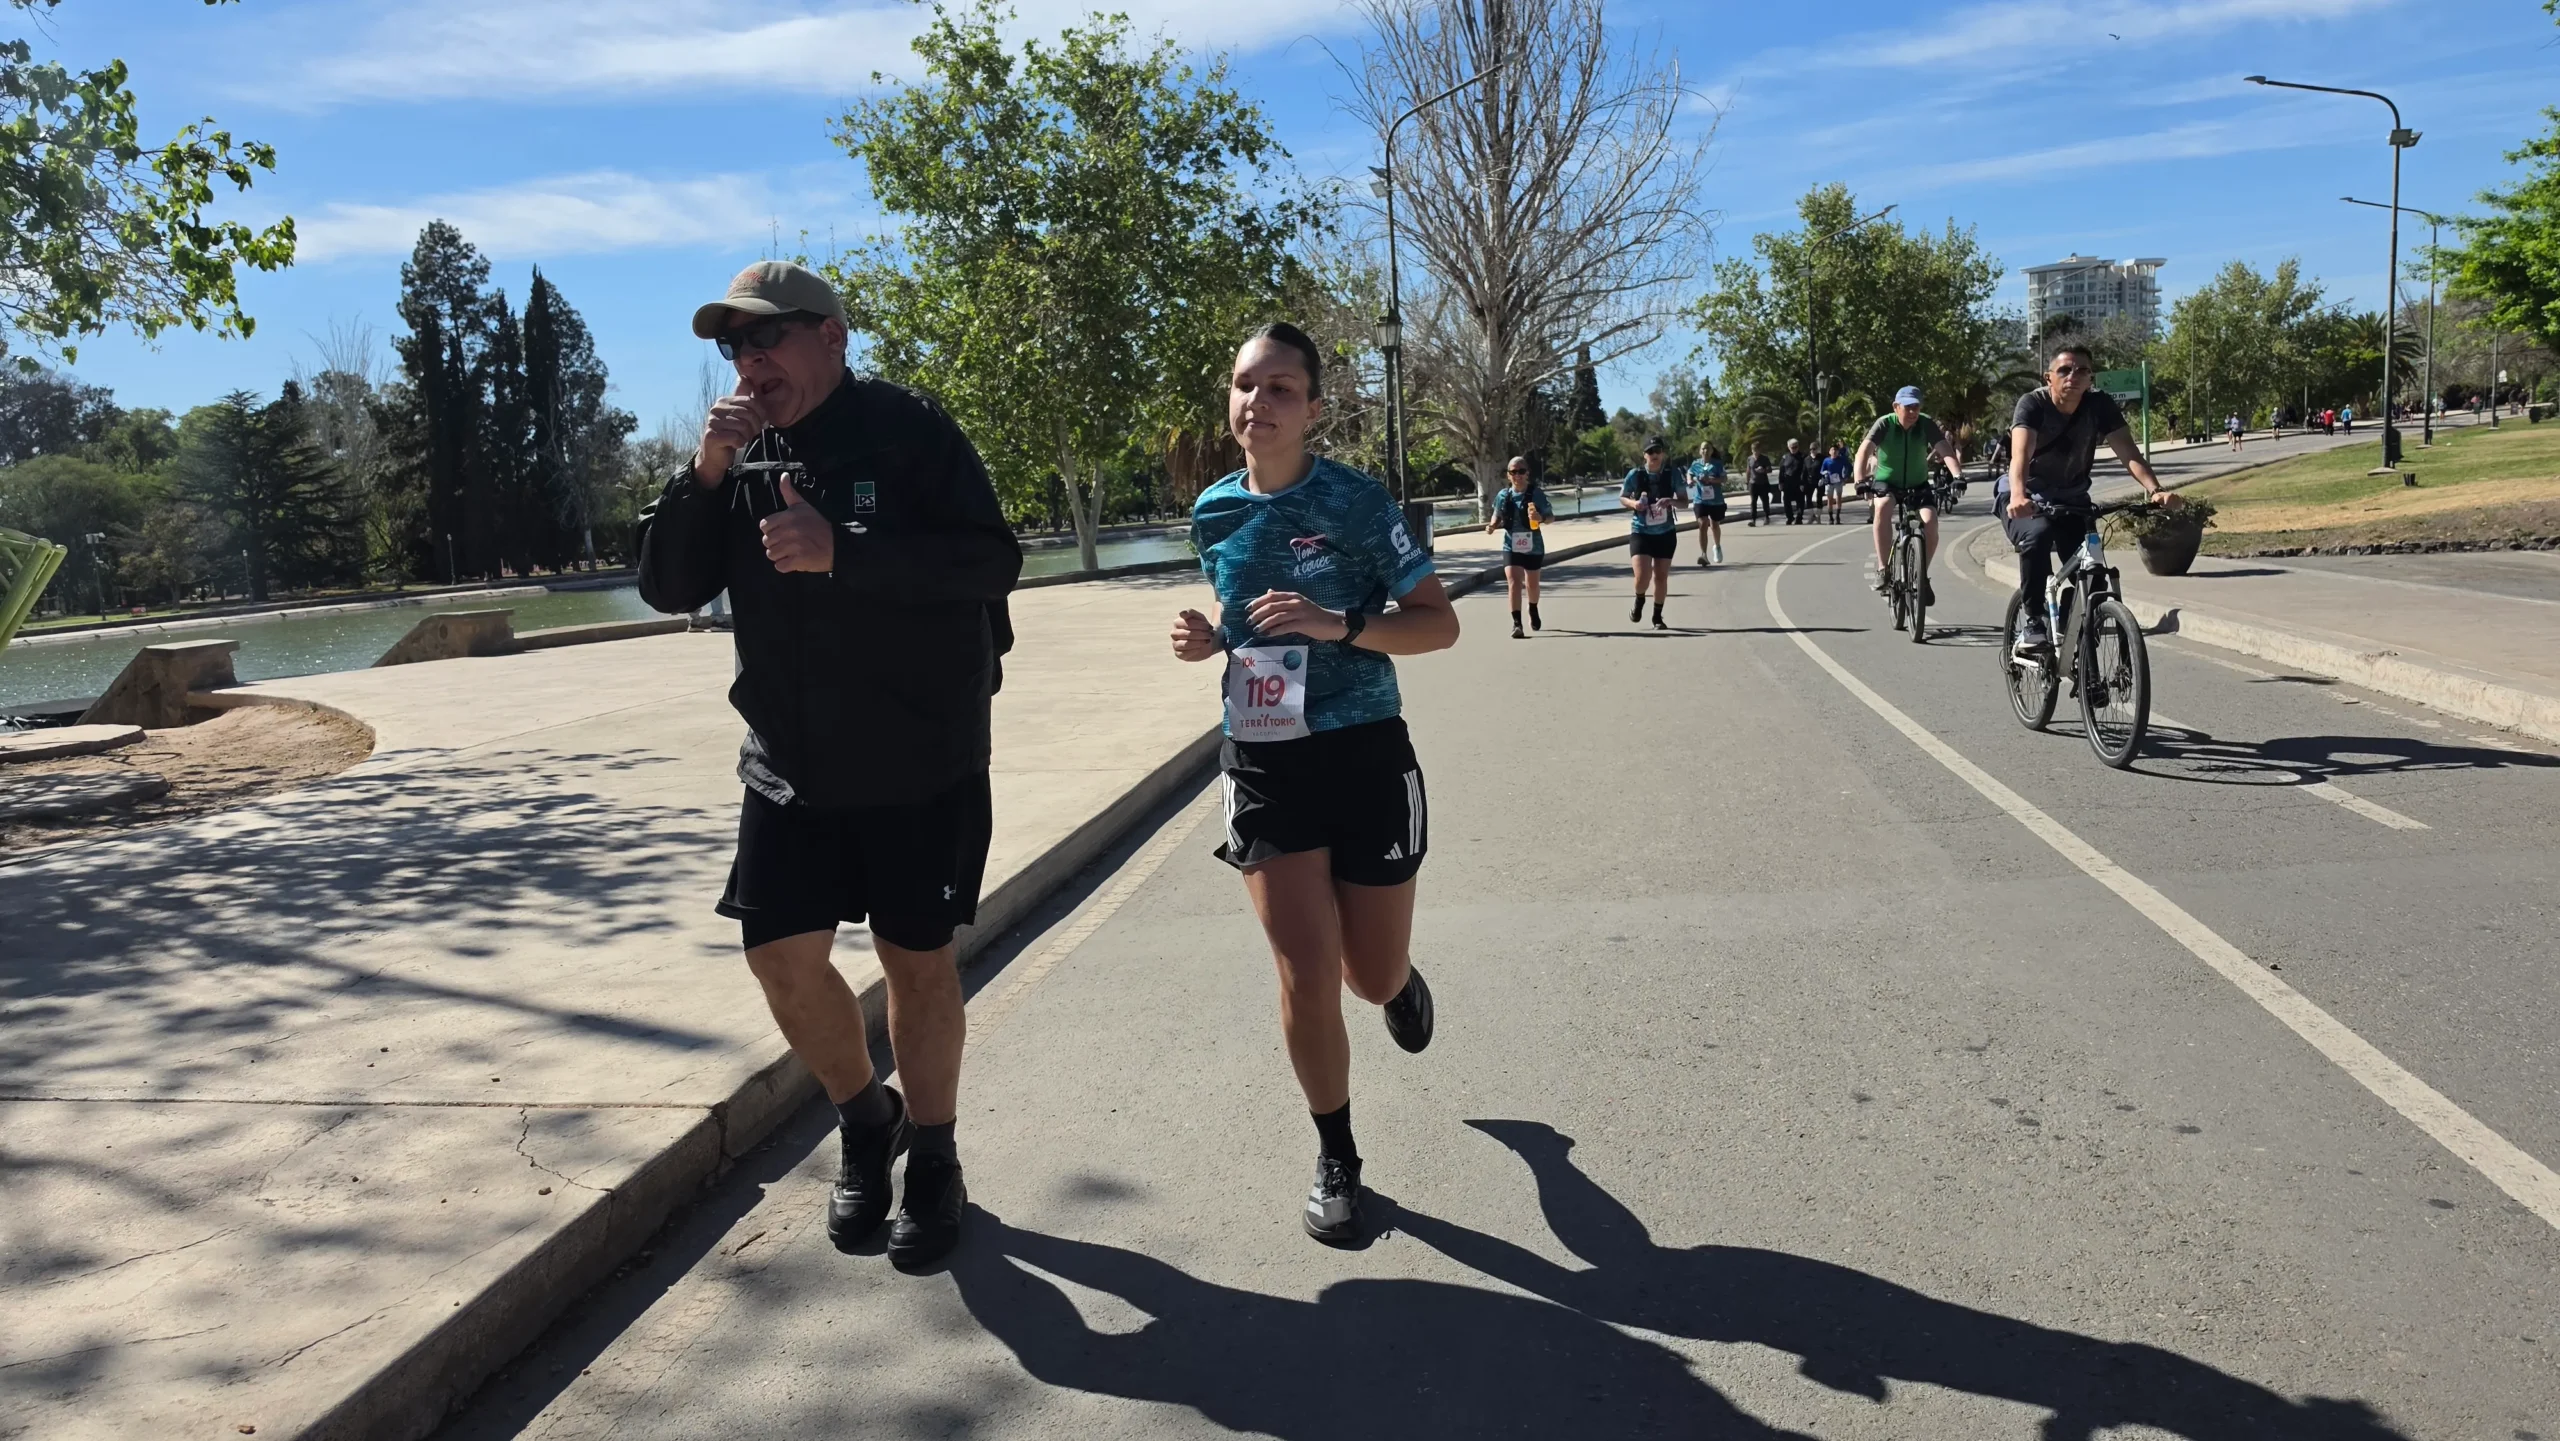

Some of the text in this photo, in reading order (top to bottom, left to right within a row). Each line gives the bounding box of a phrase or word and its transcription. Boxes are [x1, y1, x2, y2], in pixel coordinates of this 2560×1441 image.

[855, 494, 874, 506] IPS
[1516, 538, 1528, 546] 46
[1245, 674, 1285, 708] 119
[1240, 713, 1296, 728] TERRITORIO
